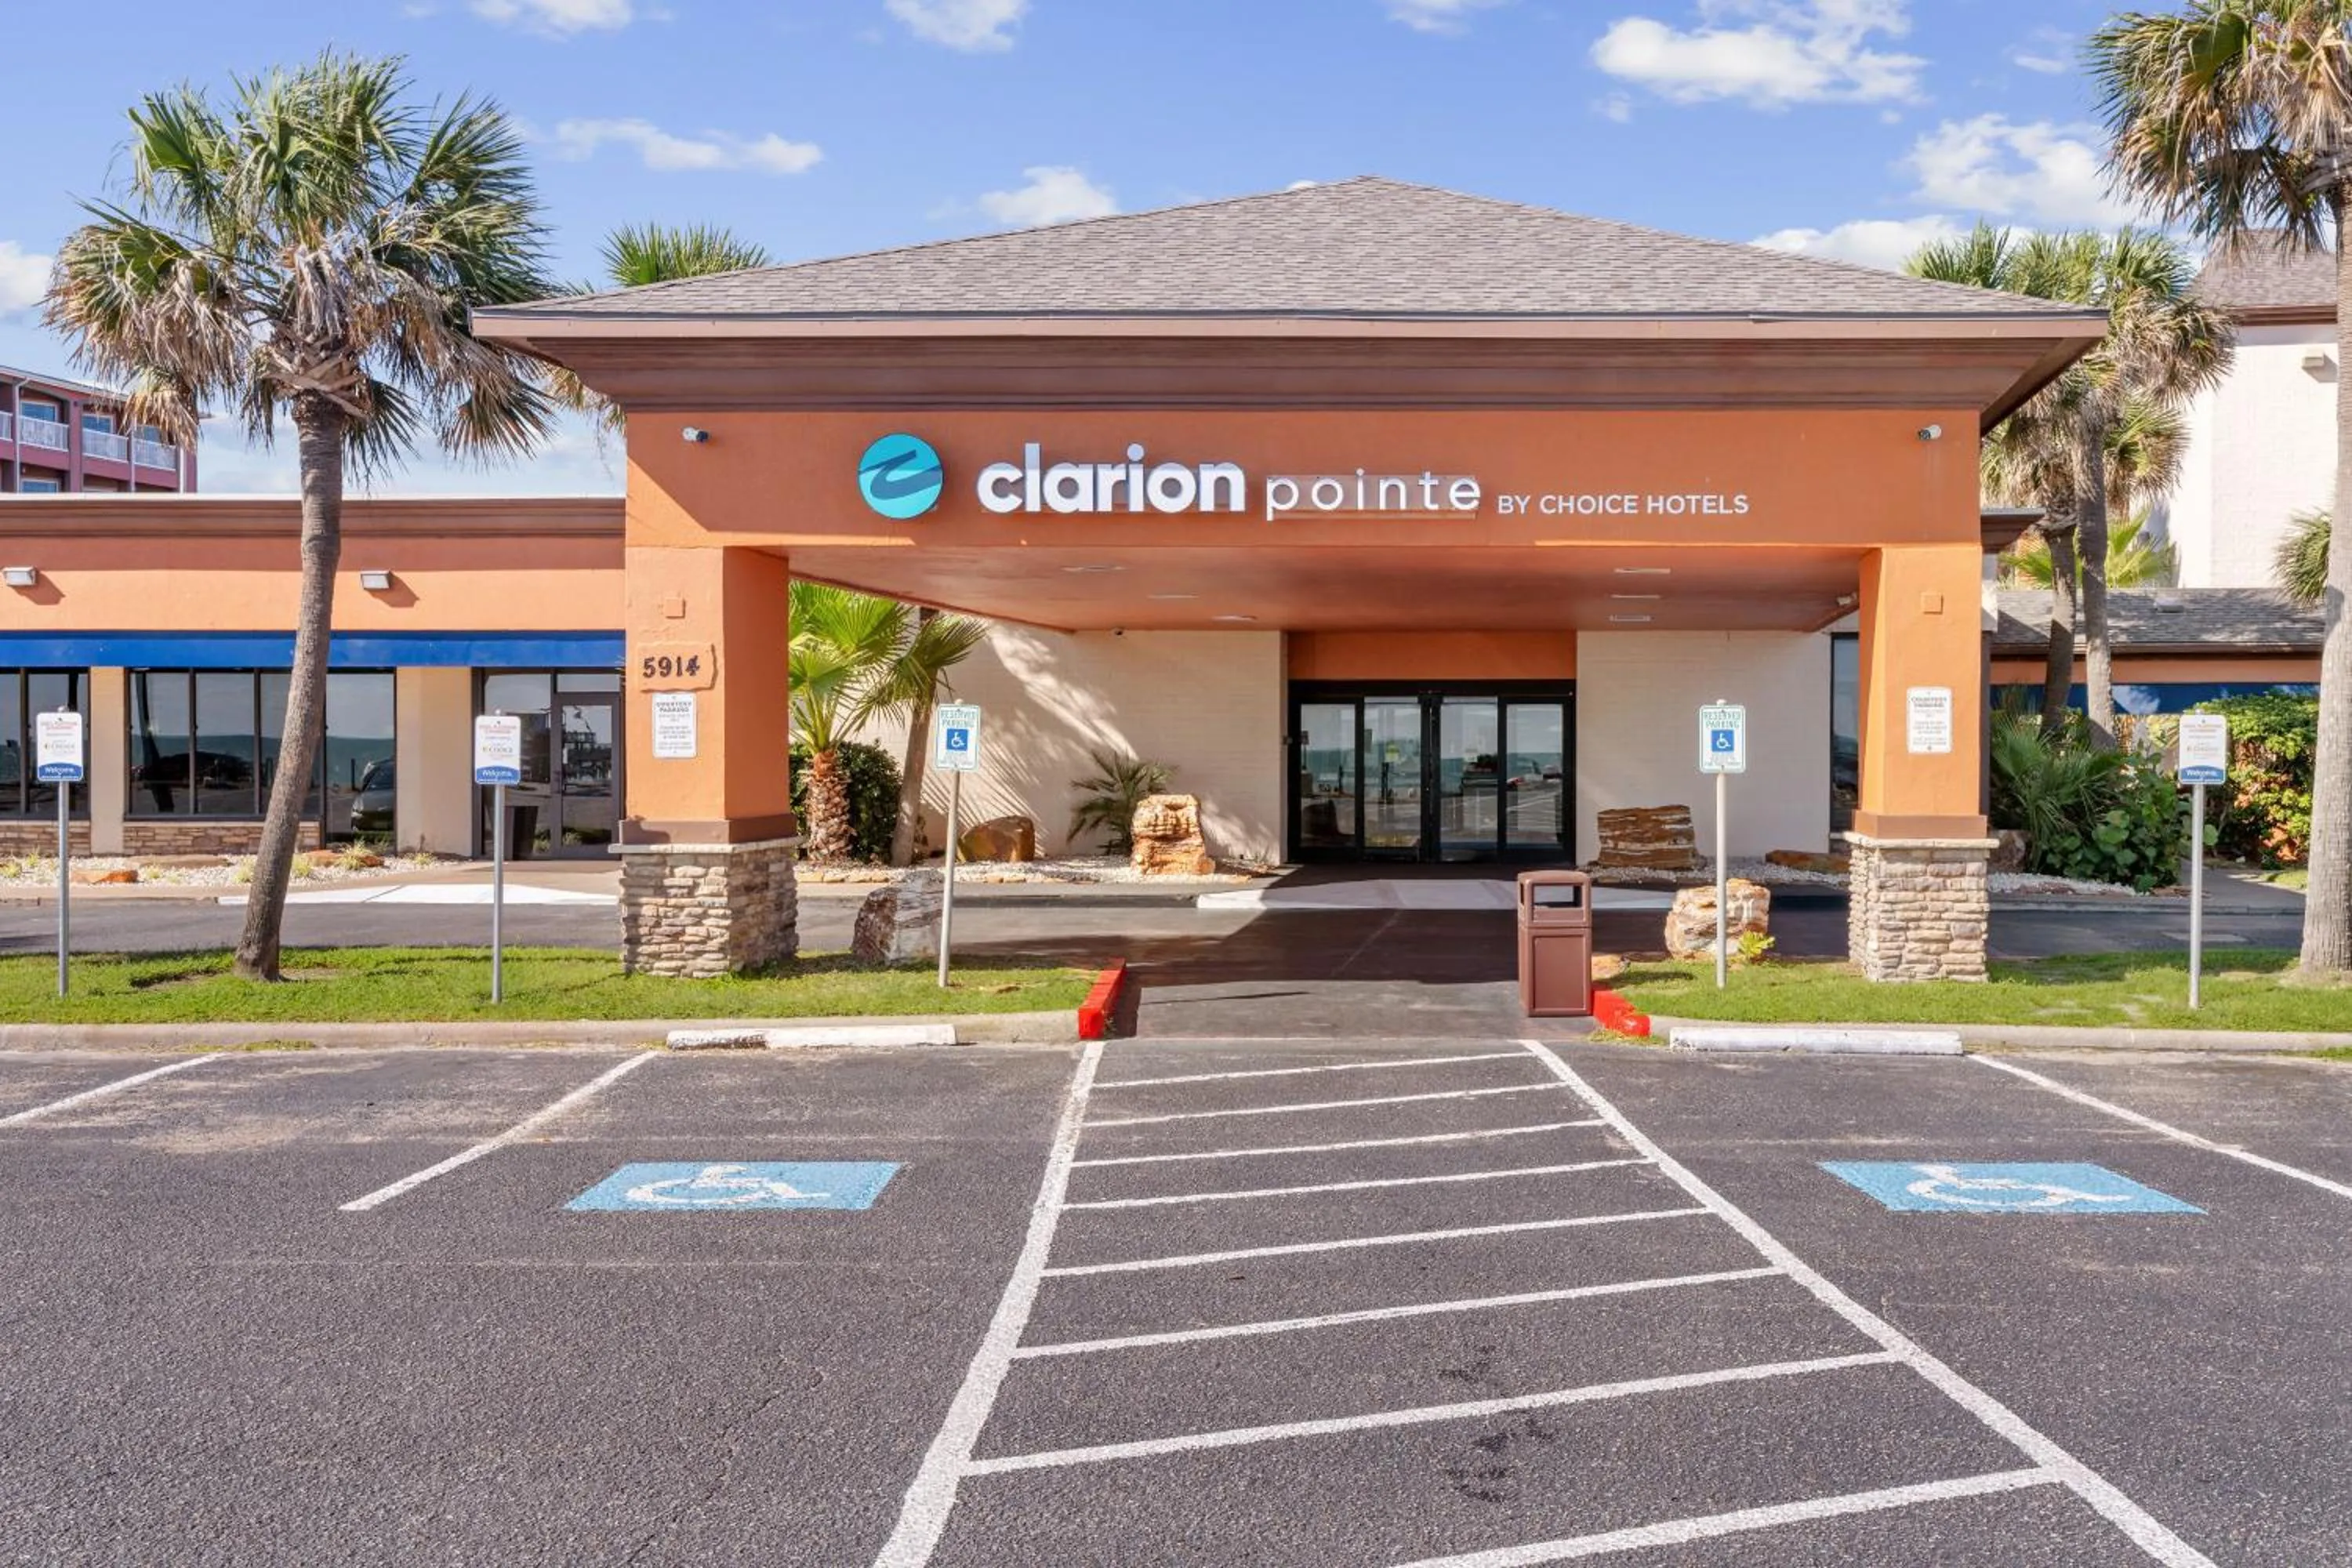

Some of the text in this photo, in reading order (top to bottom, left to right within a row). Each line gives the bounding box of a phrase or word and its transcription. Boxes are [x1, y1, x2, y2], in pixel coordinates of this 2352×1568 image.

[977, 442, 1749, 521] clarion pointe BY CHOICE HOTELS
[642, 654, 700, 679] 5914
[1704, 711, 1741, 720] RESERVED
